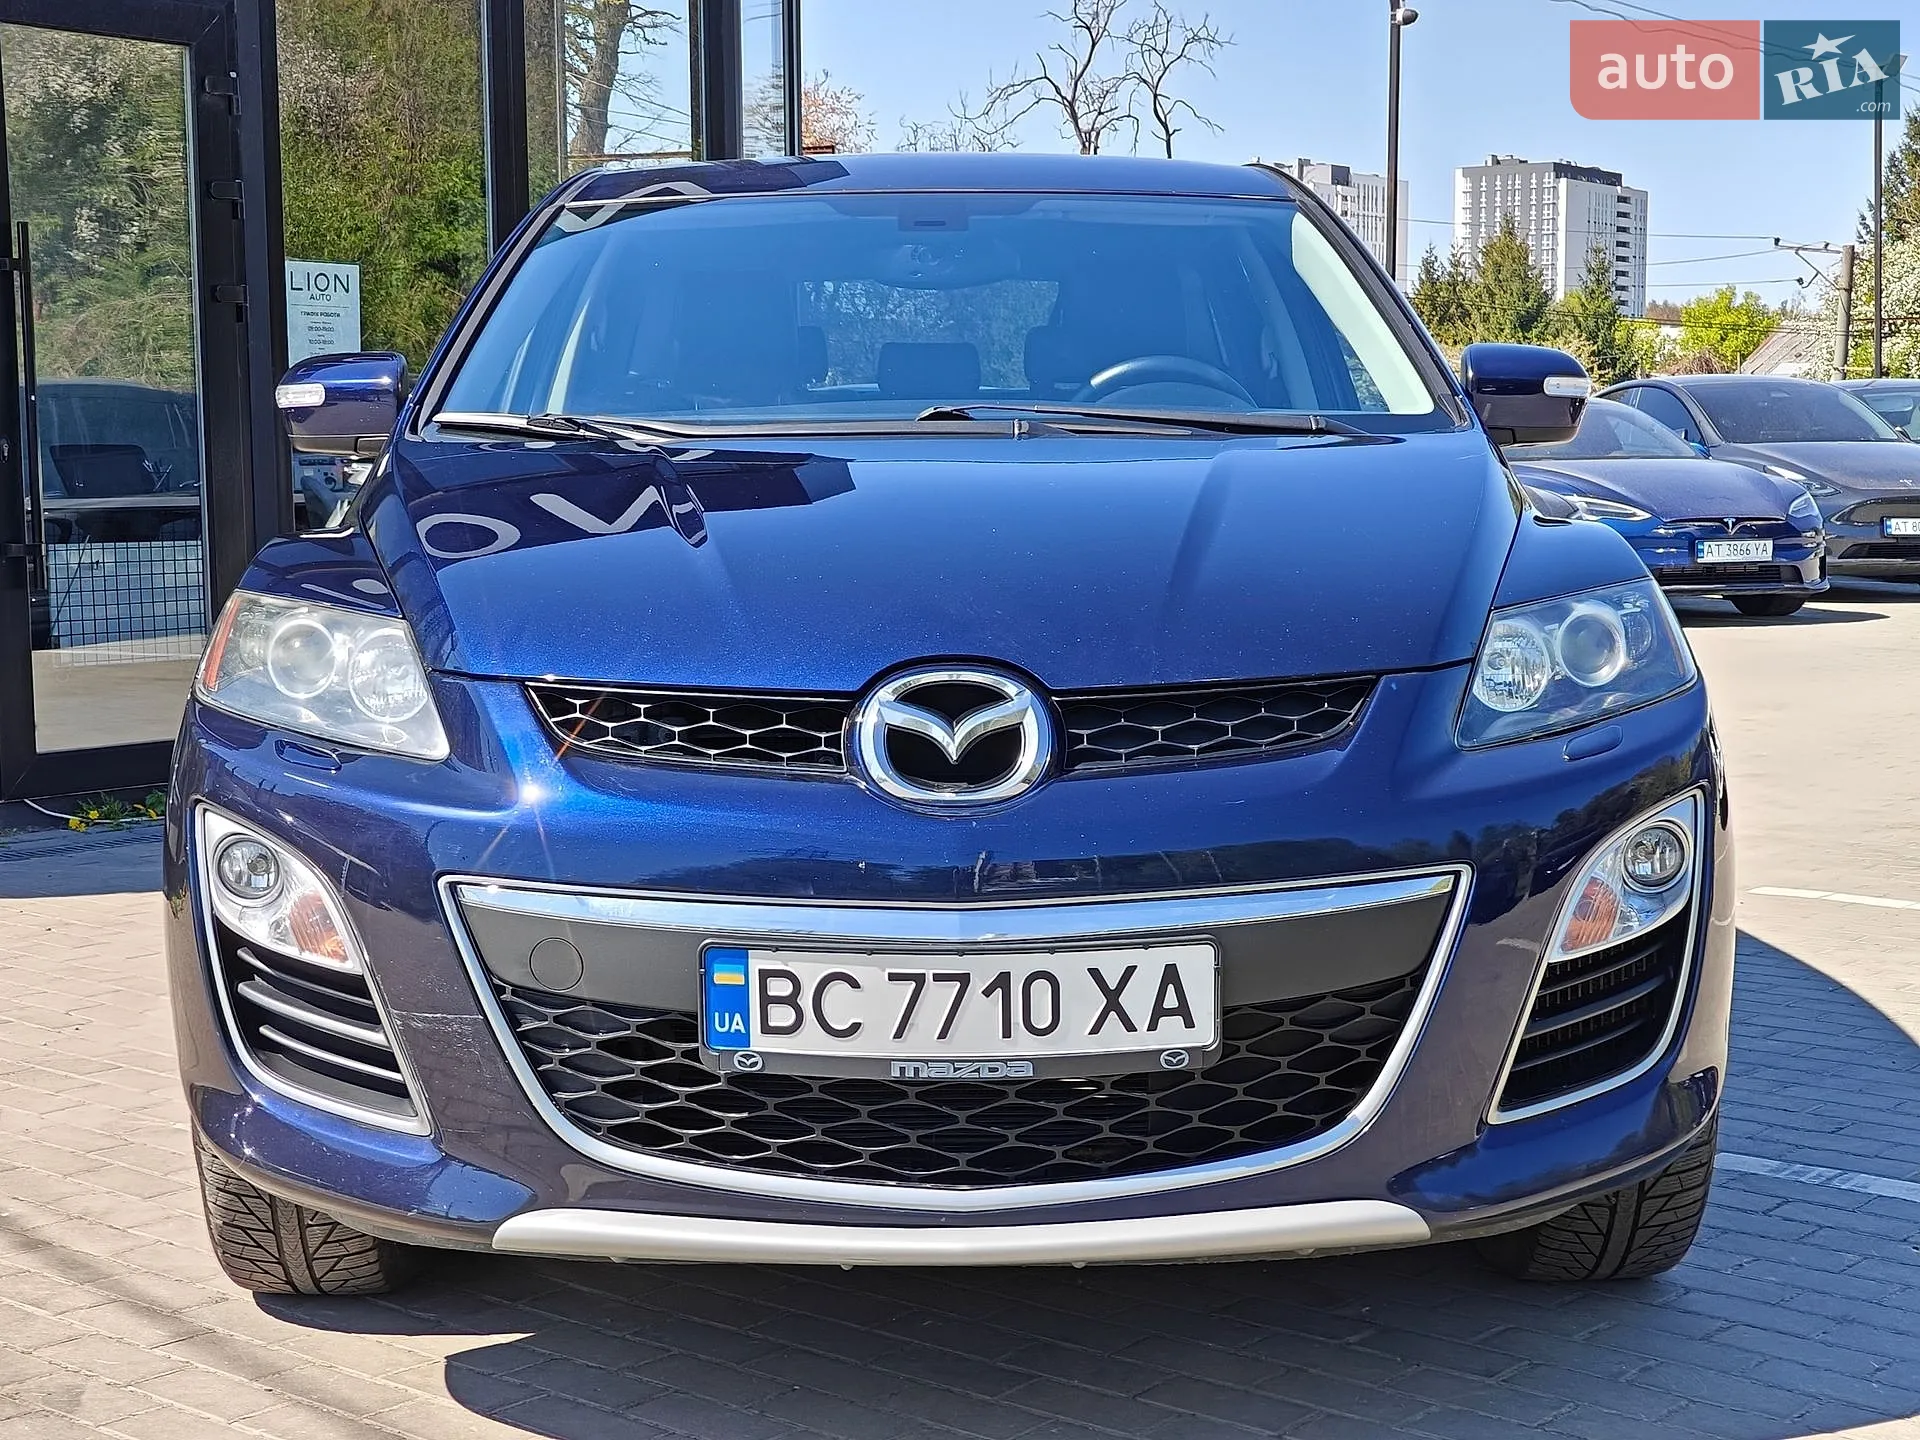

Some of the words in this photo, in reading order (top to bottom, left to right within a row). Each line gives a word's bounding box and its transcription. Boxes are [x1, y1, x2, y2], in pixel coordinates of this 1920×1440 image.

[290, 271, 350, 294] LION
[309, 294, 332, 302] AUTO
[1894, 521, 1909, 532] AT
[1706, 543, 1722, 557] AT
[1726, 543, 1751, 556] 3866
[1754, 542, 1769, 556] YA
[757, 967, 863, 1039] BC
[887, 970, 1062, 1040] 7710
[1087, 963, 1196, 1036] XA
[714, 1011, 746, 1034] UA
